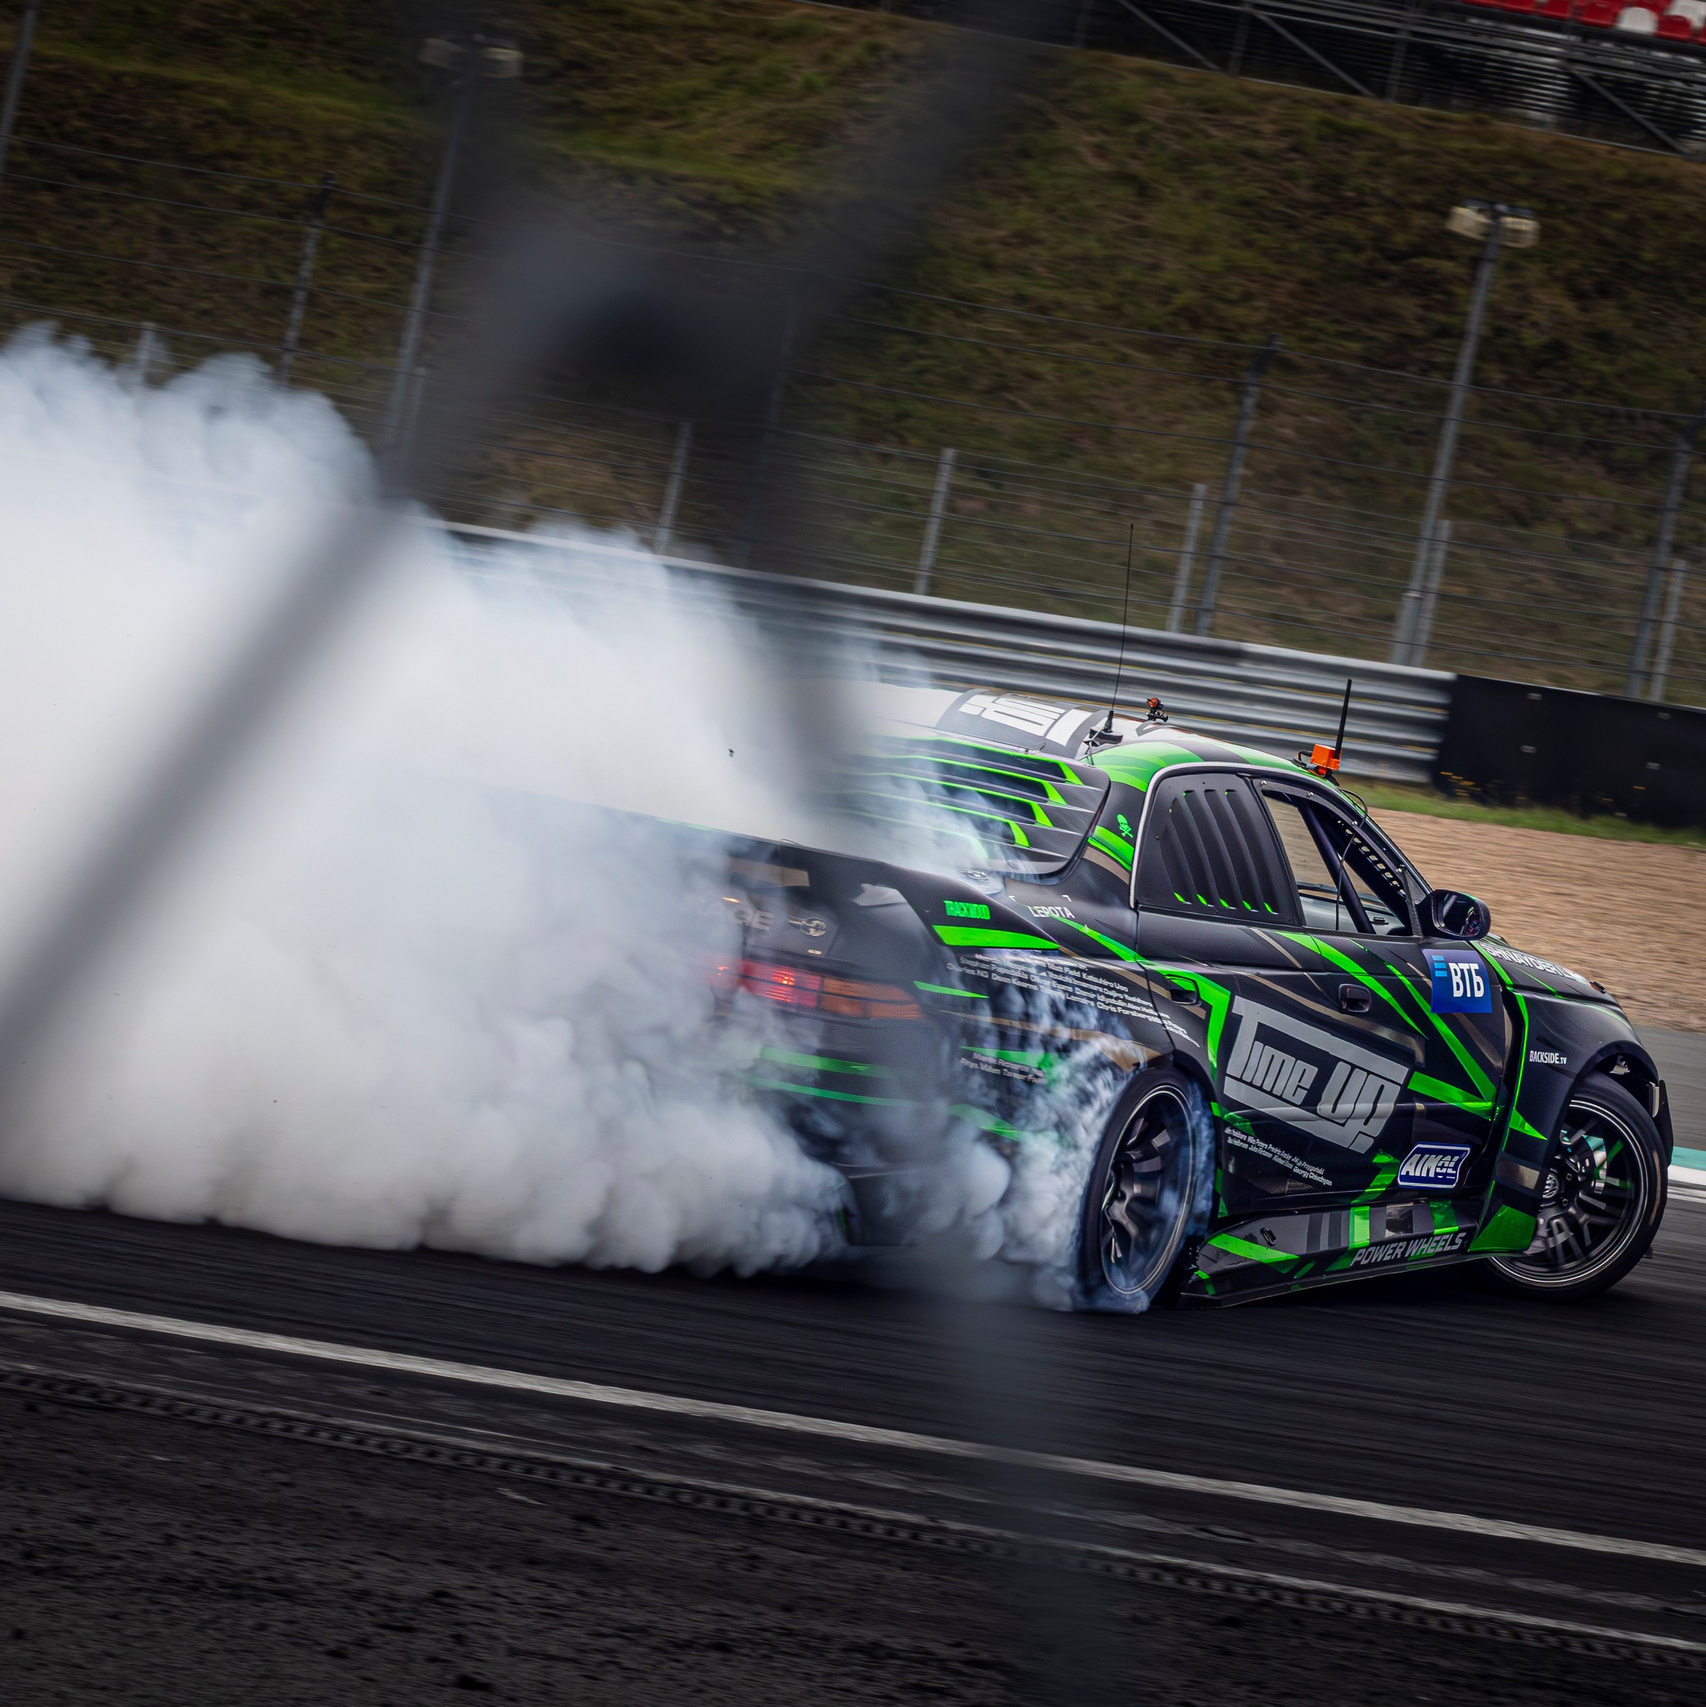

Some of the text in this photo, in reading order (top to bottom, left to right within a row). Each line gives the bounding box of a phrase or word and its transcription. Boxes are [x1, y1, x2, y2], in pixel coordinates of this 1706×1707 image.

[1027, 905, 1076, 919] LEPOTA
[1447, 961, 1486, 998] ВТБ
[1350, 1232, 1467, 1267] POWER WHEELS
